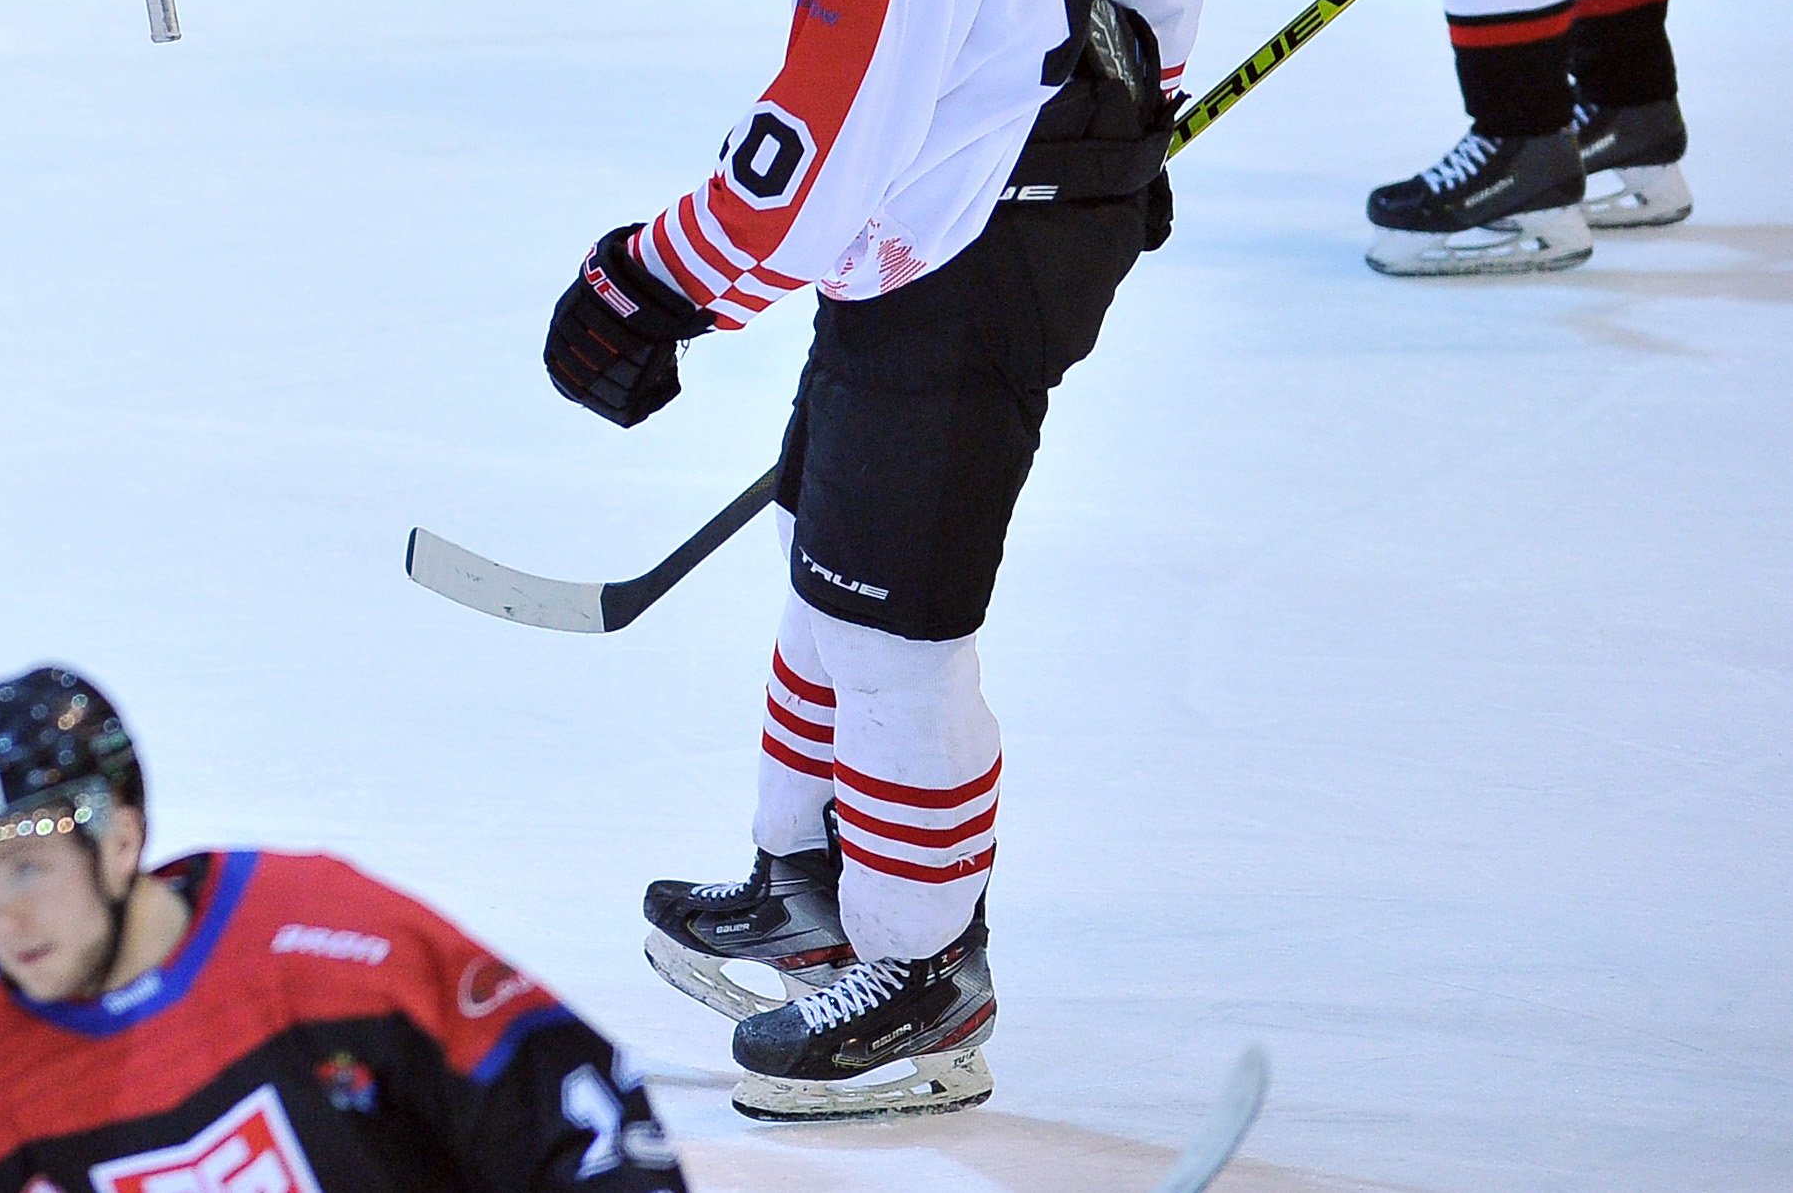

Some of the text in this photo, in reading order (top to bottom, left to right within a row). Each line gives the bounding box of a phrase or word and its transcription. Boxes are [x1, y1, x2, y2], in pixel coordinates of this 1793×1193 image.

[1173, 3, 1326, 145] TRUE
[718, 111, 806, 199] 0
[798, 545, 890, 601] TRUE
[715, 922, 751, 934] BAUER
